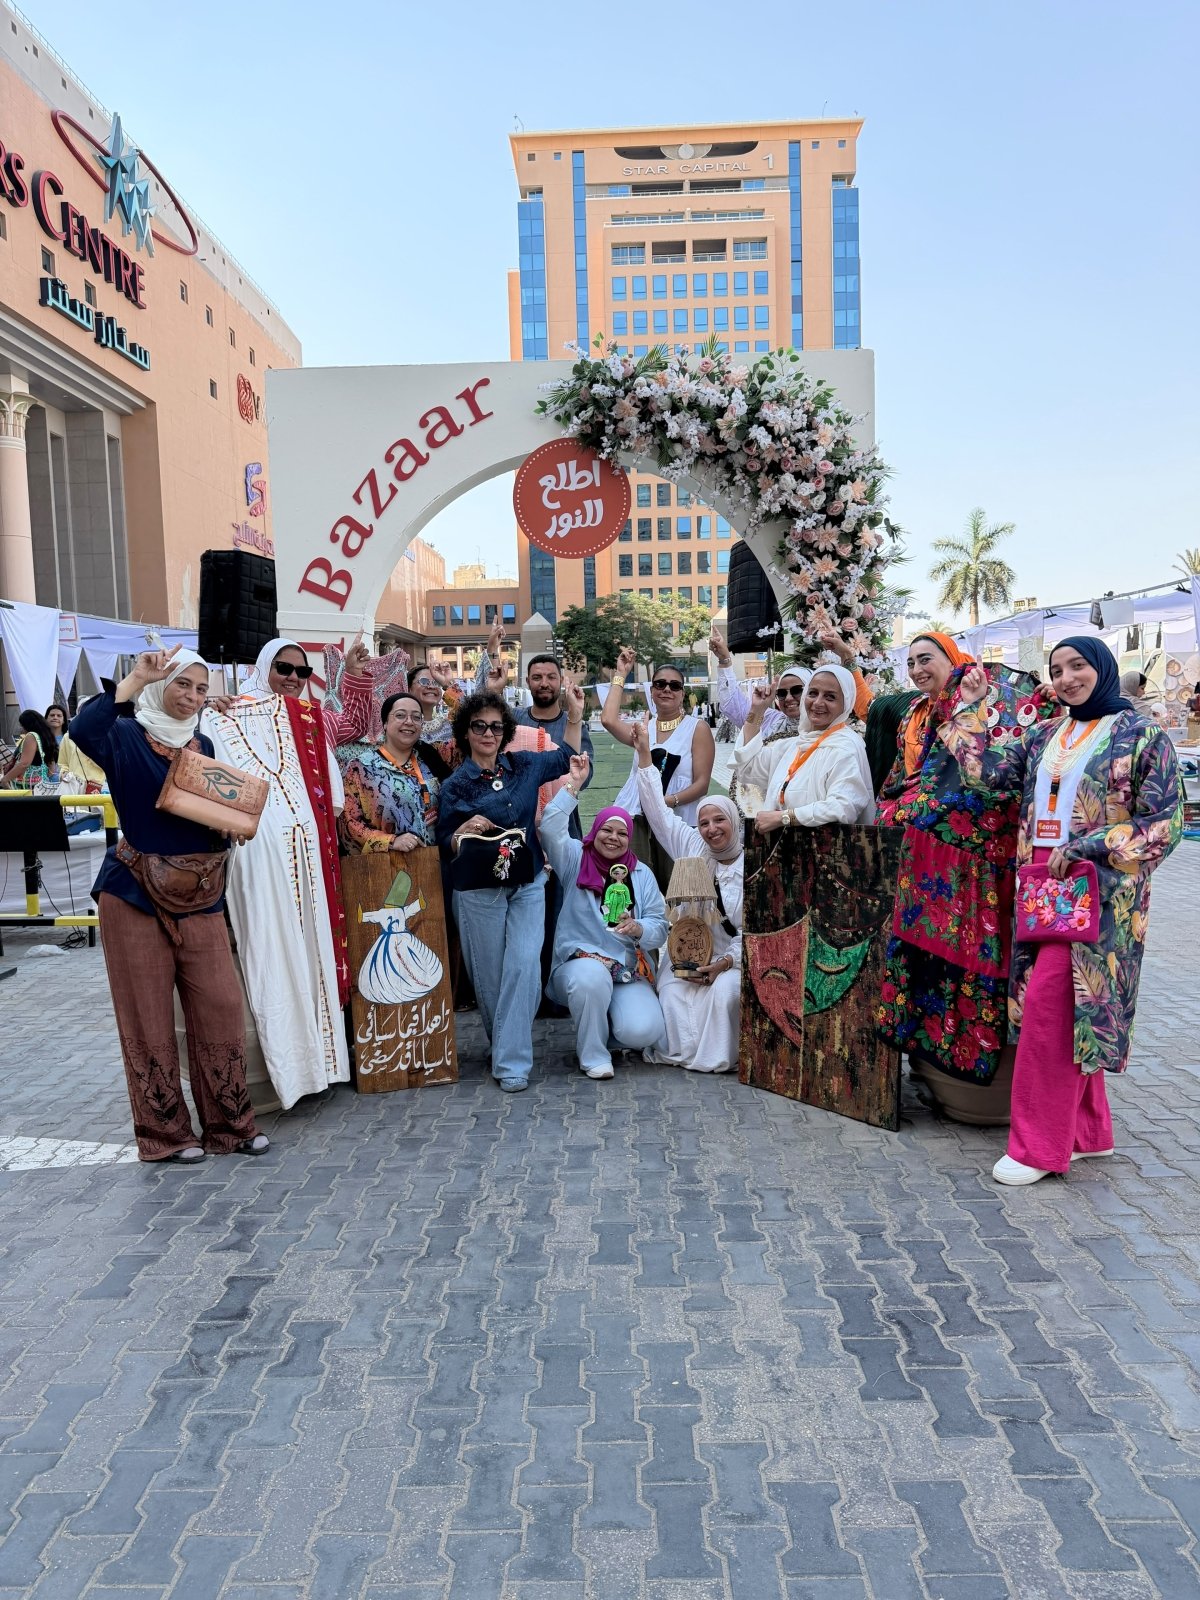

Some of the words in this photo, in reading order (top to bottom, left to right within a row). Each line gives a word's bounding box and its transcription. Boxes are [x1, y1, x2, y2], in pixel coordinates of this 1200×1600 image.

[622, 165, 669, 176] STAR
[679, 161, 752, 174] CAPITAL
[762, 152, 775, 170] 1
[297, 377, 494, 612] Bazaar
[538, 459, 601, 510] اطلع
[544, 498, 604, 539] للنور
